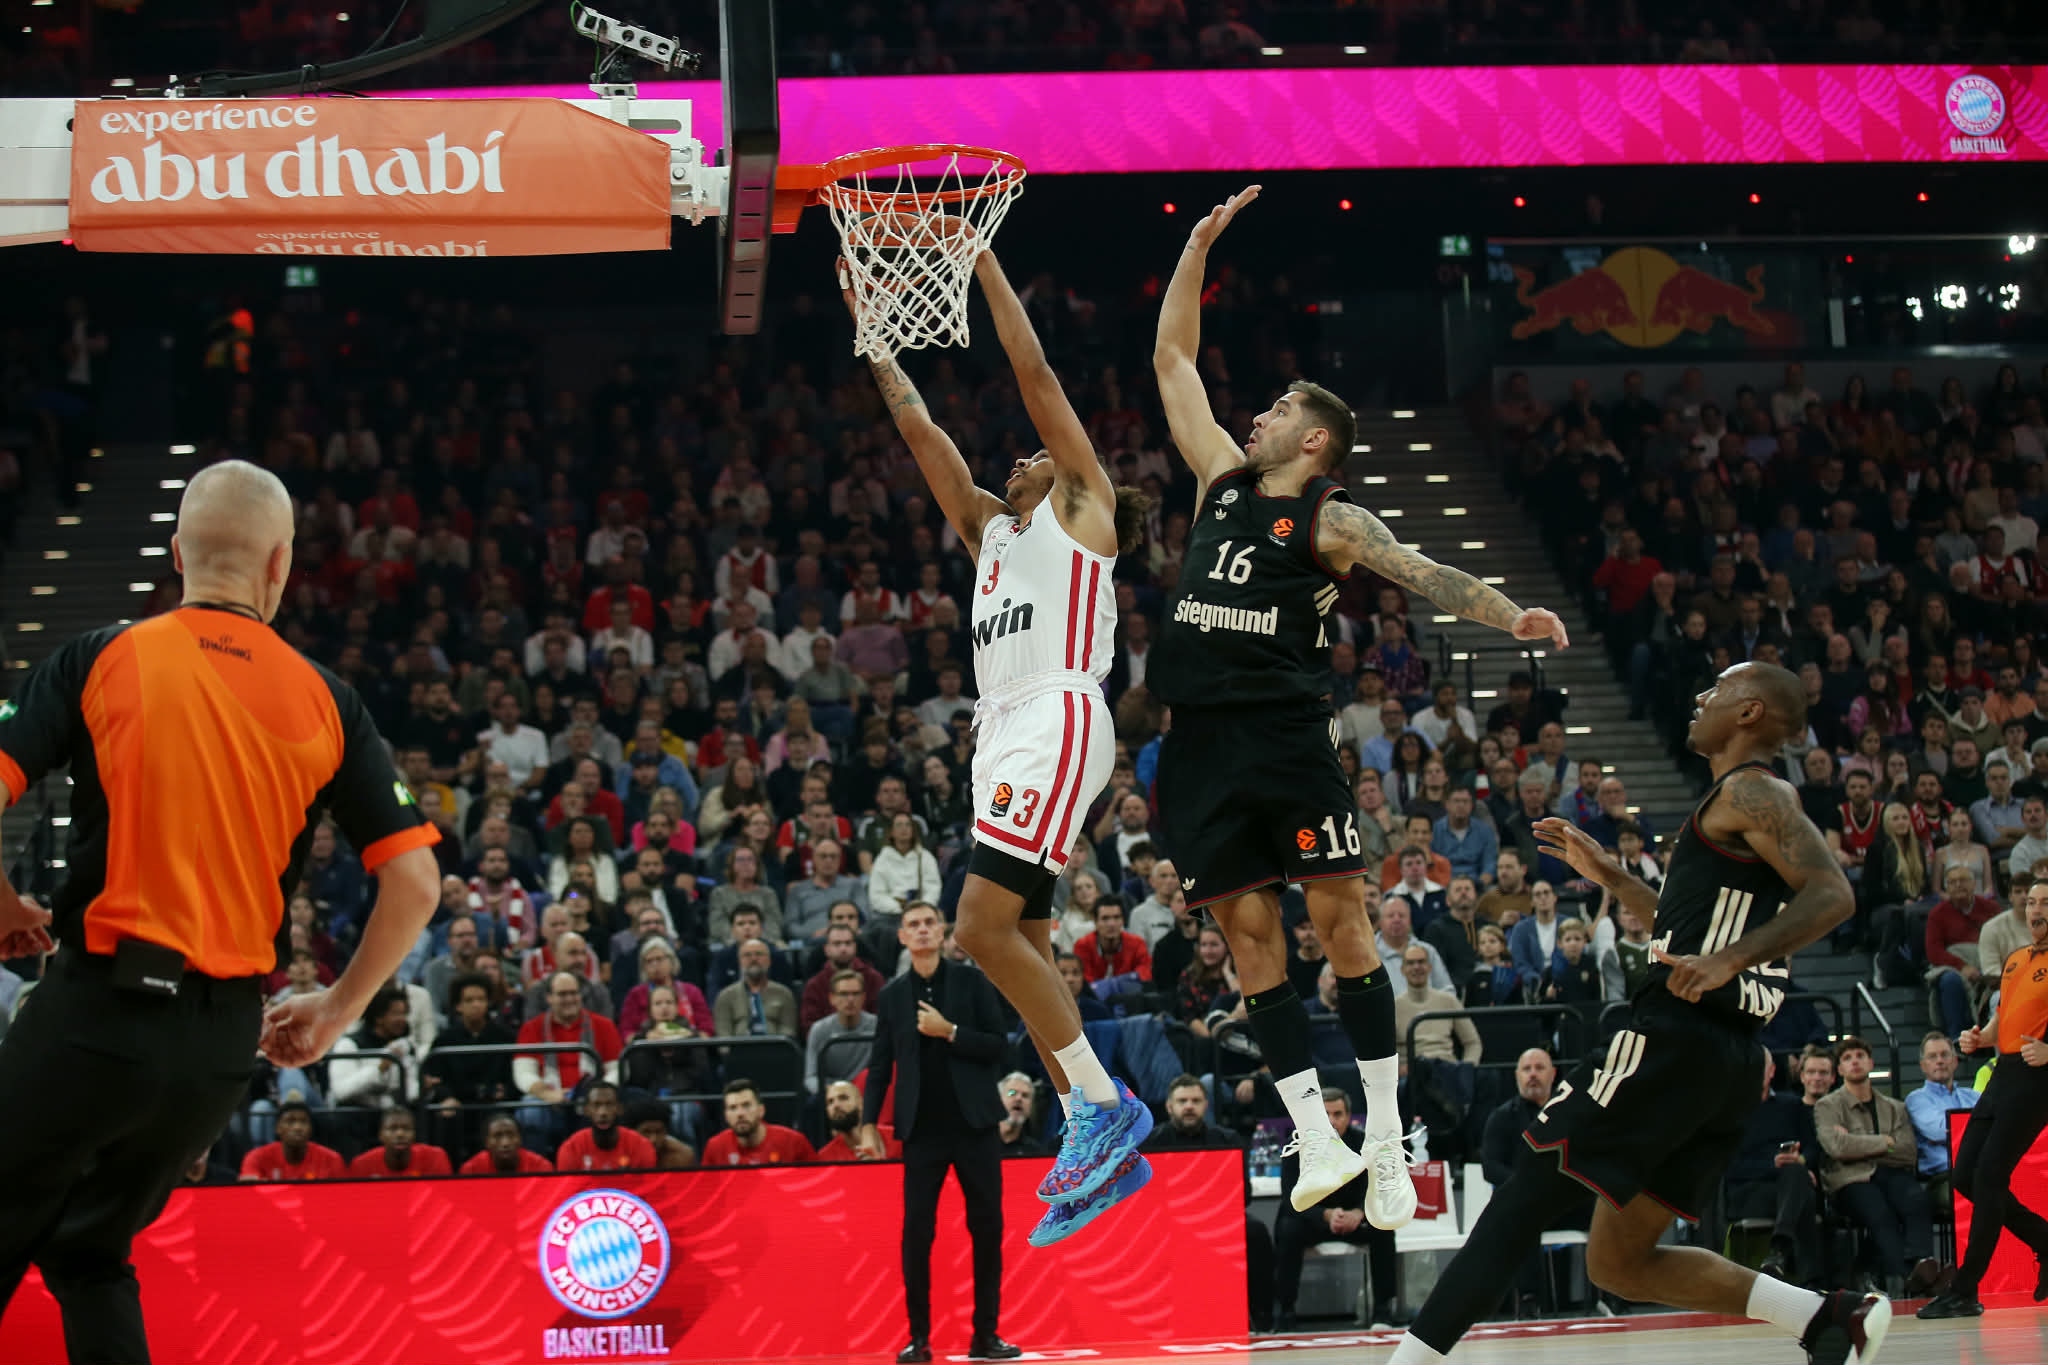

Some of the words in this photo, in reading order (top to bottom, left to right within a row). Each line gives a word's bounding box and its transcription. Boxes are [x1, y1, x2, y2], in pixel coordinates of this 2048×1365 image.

[90, 139, 249, 203] abu
[254, 240, 344, 255] abu
[982, 560, 1000, 595] 3
[1208, 540, 1257, 585] 16
[1174, 594, 1279, 636] siegmund
[1013, 788, 1041, 828] 3
[1320, 811, 1361, 860] 16
[550, 1215, 576, 1248] FC
[573, 1196, 658, 1244] BAYERN
[543, 1324, 670, 1358] BASKETBALL
